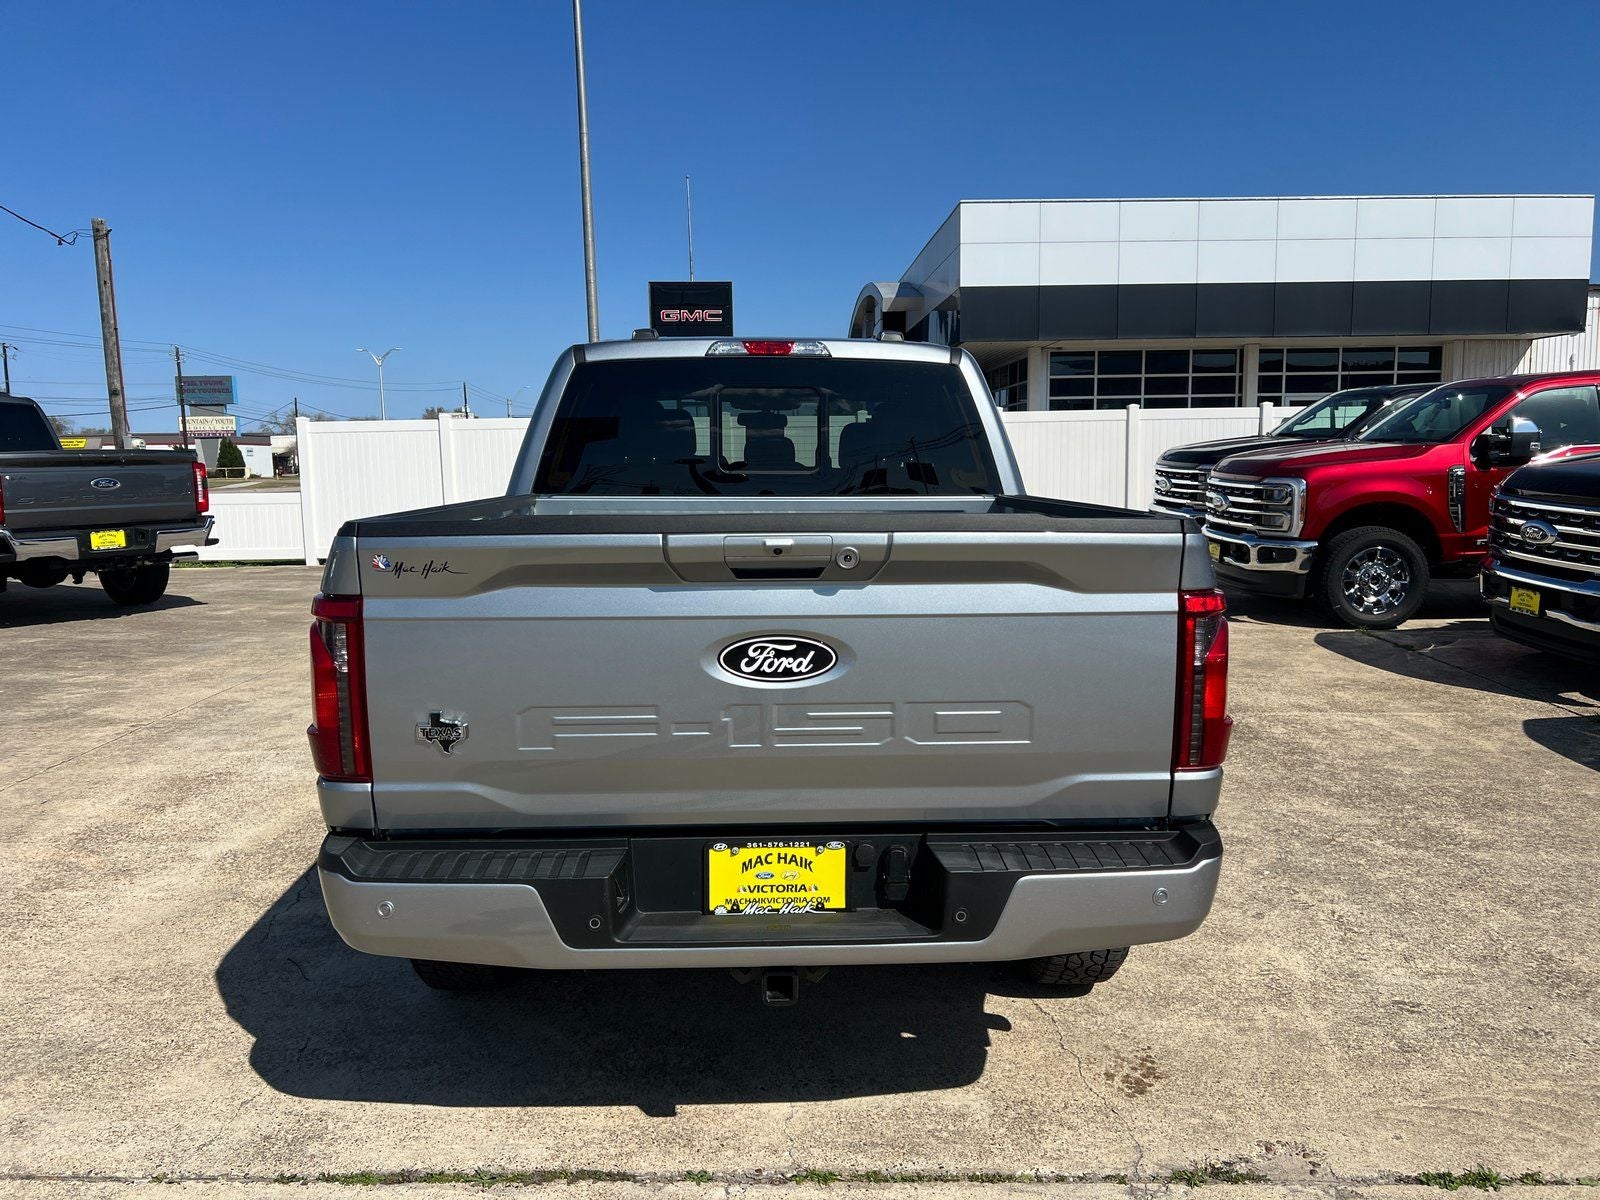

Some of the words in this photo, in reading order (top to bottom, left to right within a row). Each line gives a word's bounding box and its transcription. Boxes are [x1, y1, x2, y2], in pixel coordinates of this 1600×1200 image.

[660, 309, 722, 322] GMC
[1524, 527, 1542, 540] Ford
[393, 561, 419, 579] Mac
[421, 560, 455, 579] Haik
[740, 642, 815, 675] Ford
[419, 727, 462, 737] TEXAS
[516, 701, 1033, 751] F-150
[741, 853, 773, 874] MAC
[777, 853, 814, 873] HAIK
[747, 884, 808, 893] VICTORIA
[742, 902, 777, 915] Mac
[777, 901, 820, 915] Haik
